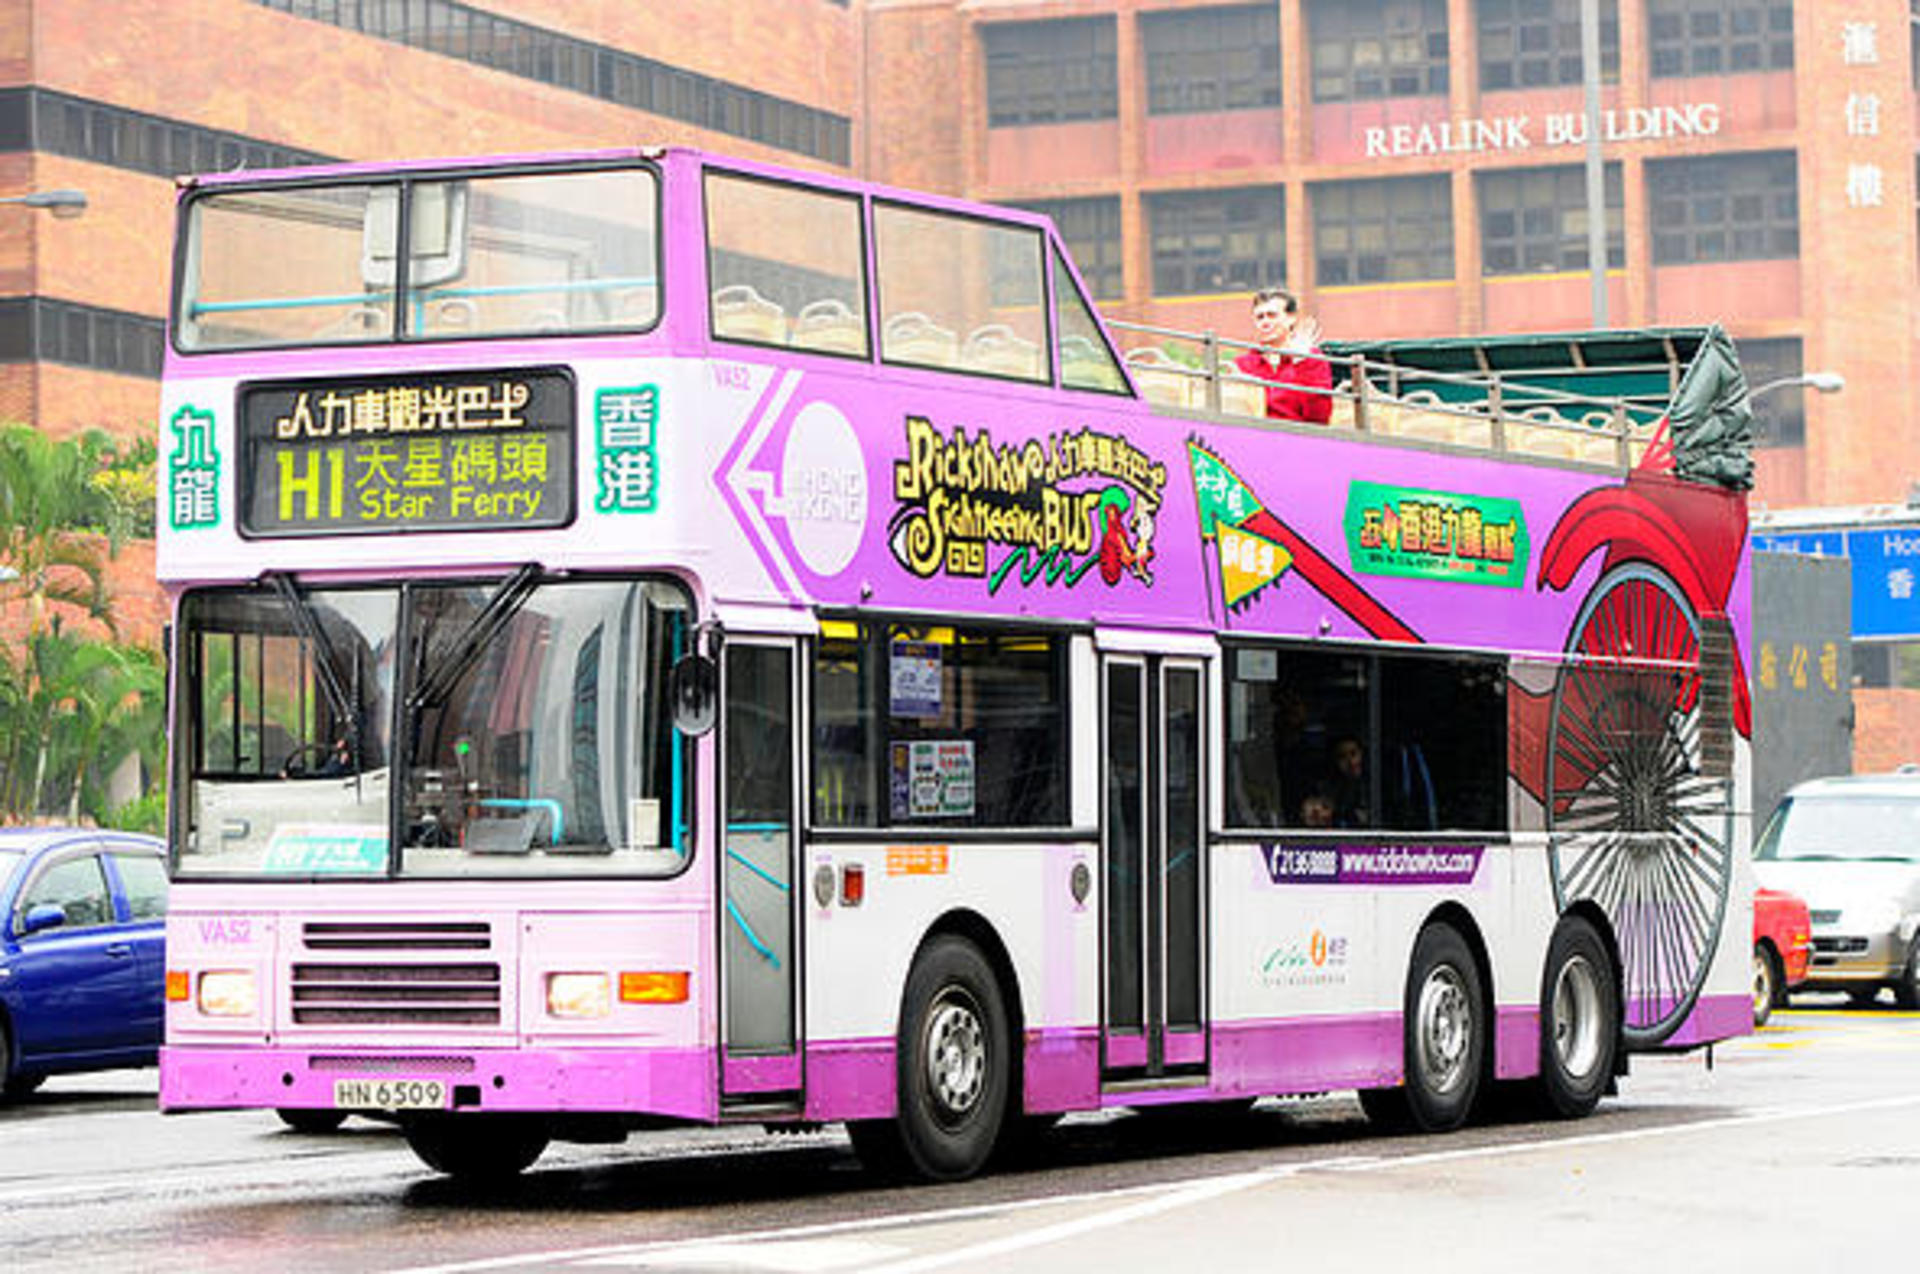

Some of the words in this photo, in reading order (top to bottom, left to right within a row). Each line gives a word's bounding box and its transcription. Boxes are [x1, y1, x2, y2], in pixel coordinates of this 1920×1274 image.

[1365, 116, 1530, 157] REALINK
[1545, 103, 1720, 146] BULDING
[278, 383, 530, 438] 人力車觀光巴士
[172, 408, 220, 528] 九龍
[354, 431, 548, 489] 天星碼頭
[597, 386, 657, 512] 香港
[894, 415, 1044, 500] Rickshaw
[276, 447, 345, 520] H1
[359, 492, 434, 519] Star
[450, 487, 542, 519] Ferry
[1042, 486, 1101, 554] BUS
[199, 920, 251, 944] VA52
[337, 1083, 371, 1107] HN
[376, 1081, 442, 1107] 6509
